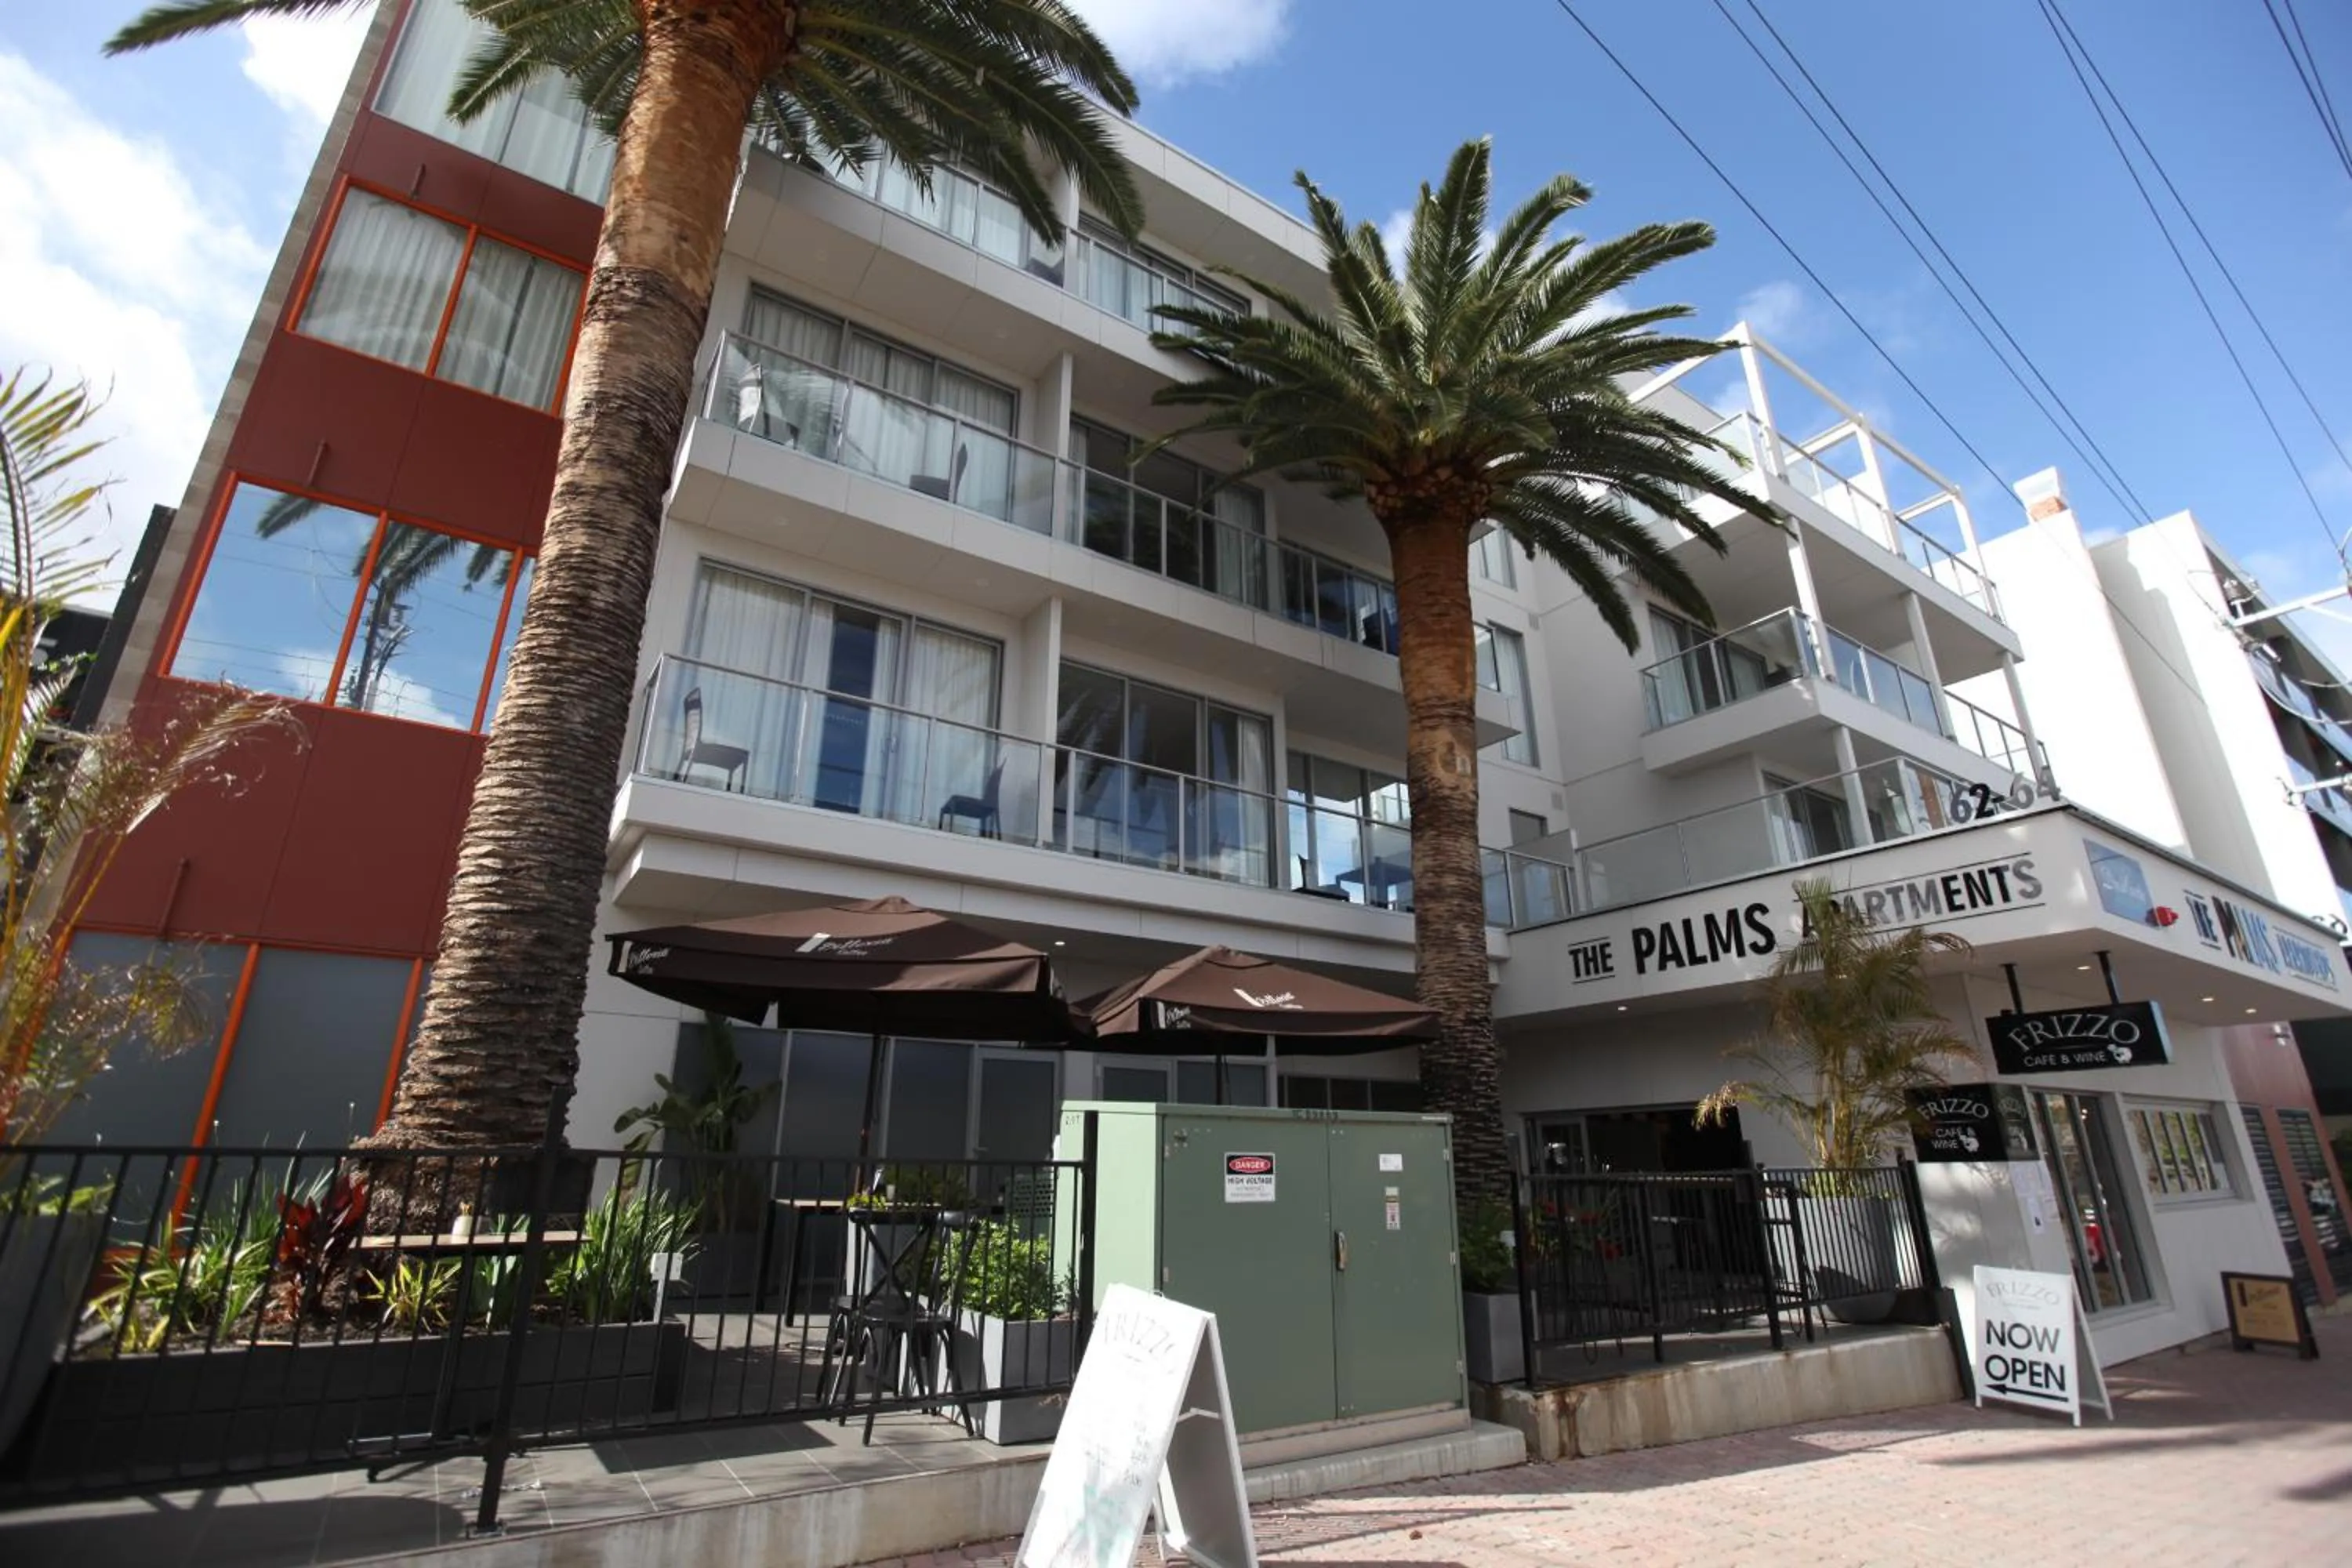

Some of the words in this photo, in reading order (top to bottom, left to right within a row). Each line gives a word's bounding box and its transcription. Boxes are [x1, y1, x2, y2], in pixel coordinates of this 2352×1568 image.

[1569, 942, 1615, 978] THE
[1632, 903, 1776, 975] PALMS
[1801, 860, 2043, 937] ARTMENTS
[2008, 1014, 2140, 1052] FRIZZO
[2024, 1054, 2057, 1067] CAFE
[2073, 1051, 2107, 1064] WINE
[1917, 1098, 1990, 1120] FRIZZO
[1931, 1139, 1959, 1149] WINE
[1986, 1280, 2060, 1305] FRIZZO
[1986, 1319, 2060, 1353] NOW
[1984, 1354, 2066, 1392] OPEN
